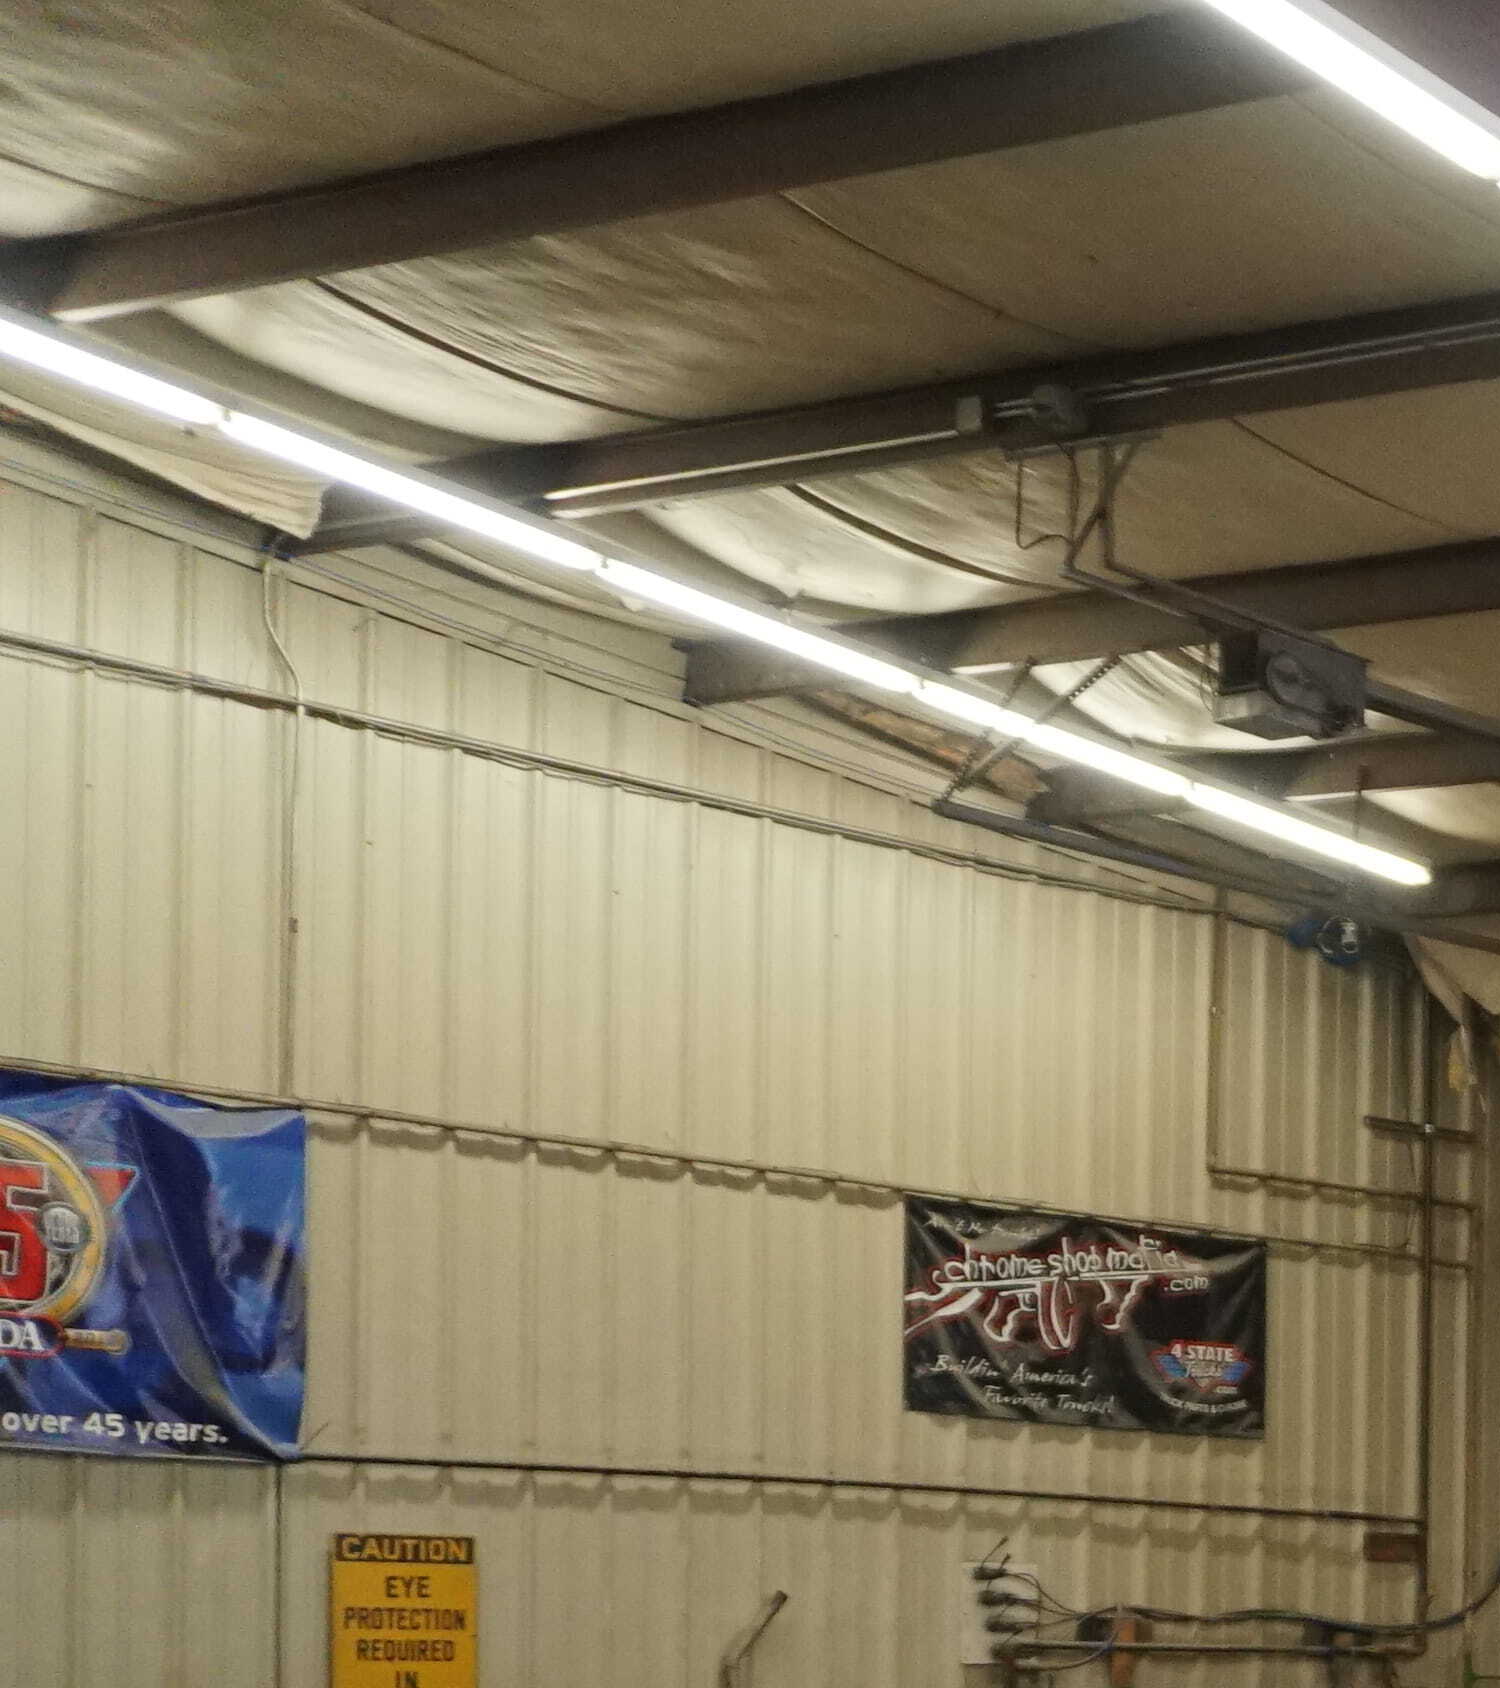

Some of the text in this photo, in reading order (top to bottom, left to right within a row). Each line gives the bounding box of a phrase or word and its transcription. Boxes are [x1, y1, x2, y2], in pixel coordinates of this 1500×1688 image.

[1171, 1343, 1234, 1362] 4 STATE
[2, 1411, 228, 1444] over 45 years.
[341, 1536, 467, 1561] CAUTION
[385, 1576, 431, 1599] EYE
[343, 1606, 466, 1631] PROTECTION
[356, 1638, 456, 1662] REQUIRED
